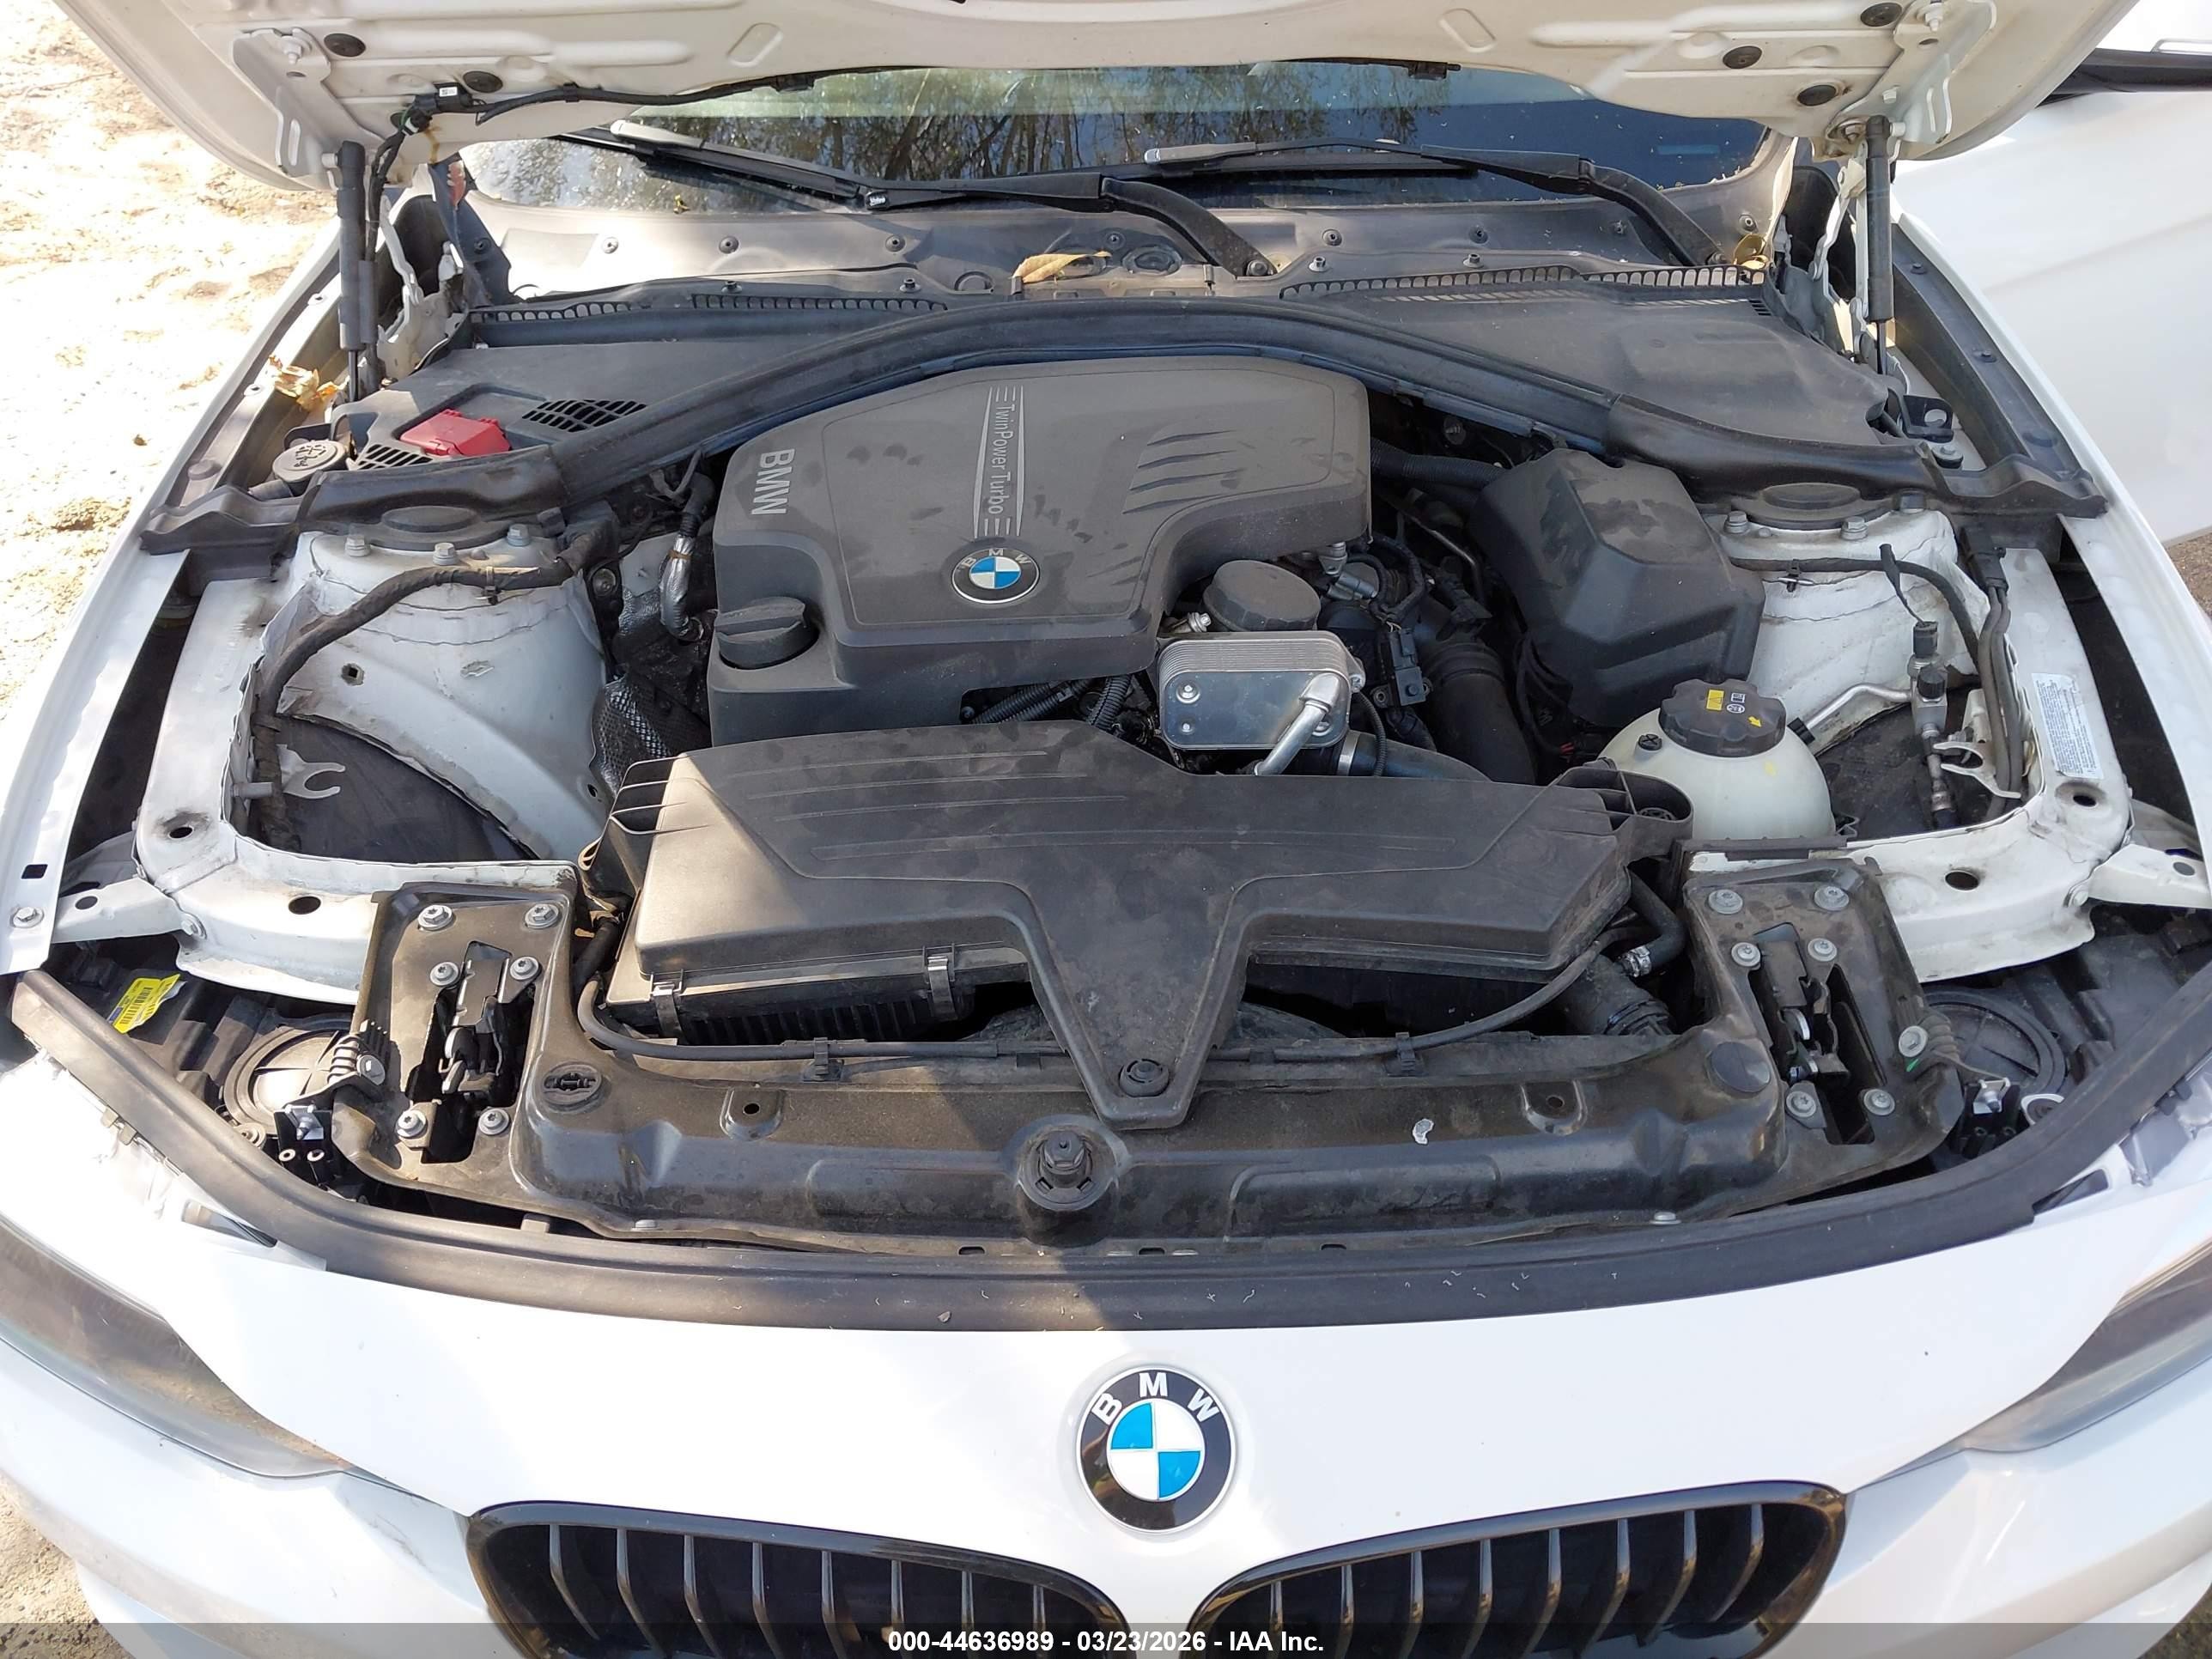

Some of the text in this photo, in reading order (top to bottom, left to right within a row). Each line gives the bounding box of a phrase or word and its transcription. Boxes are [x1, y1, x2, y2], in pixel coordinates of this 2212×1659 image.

[751, 448, 795, 514] BMW
[988, 404, 1015, 514] TwinPower Turbo
[960, 549, 1031, 568] BMW
[1091, 1371, 1220, 1425] BMW
